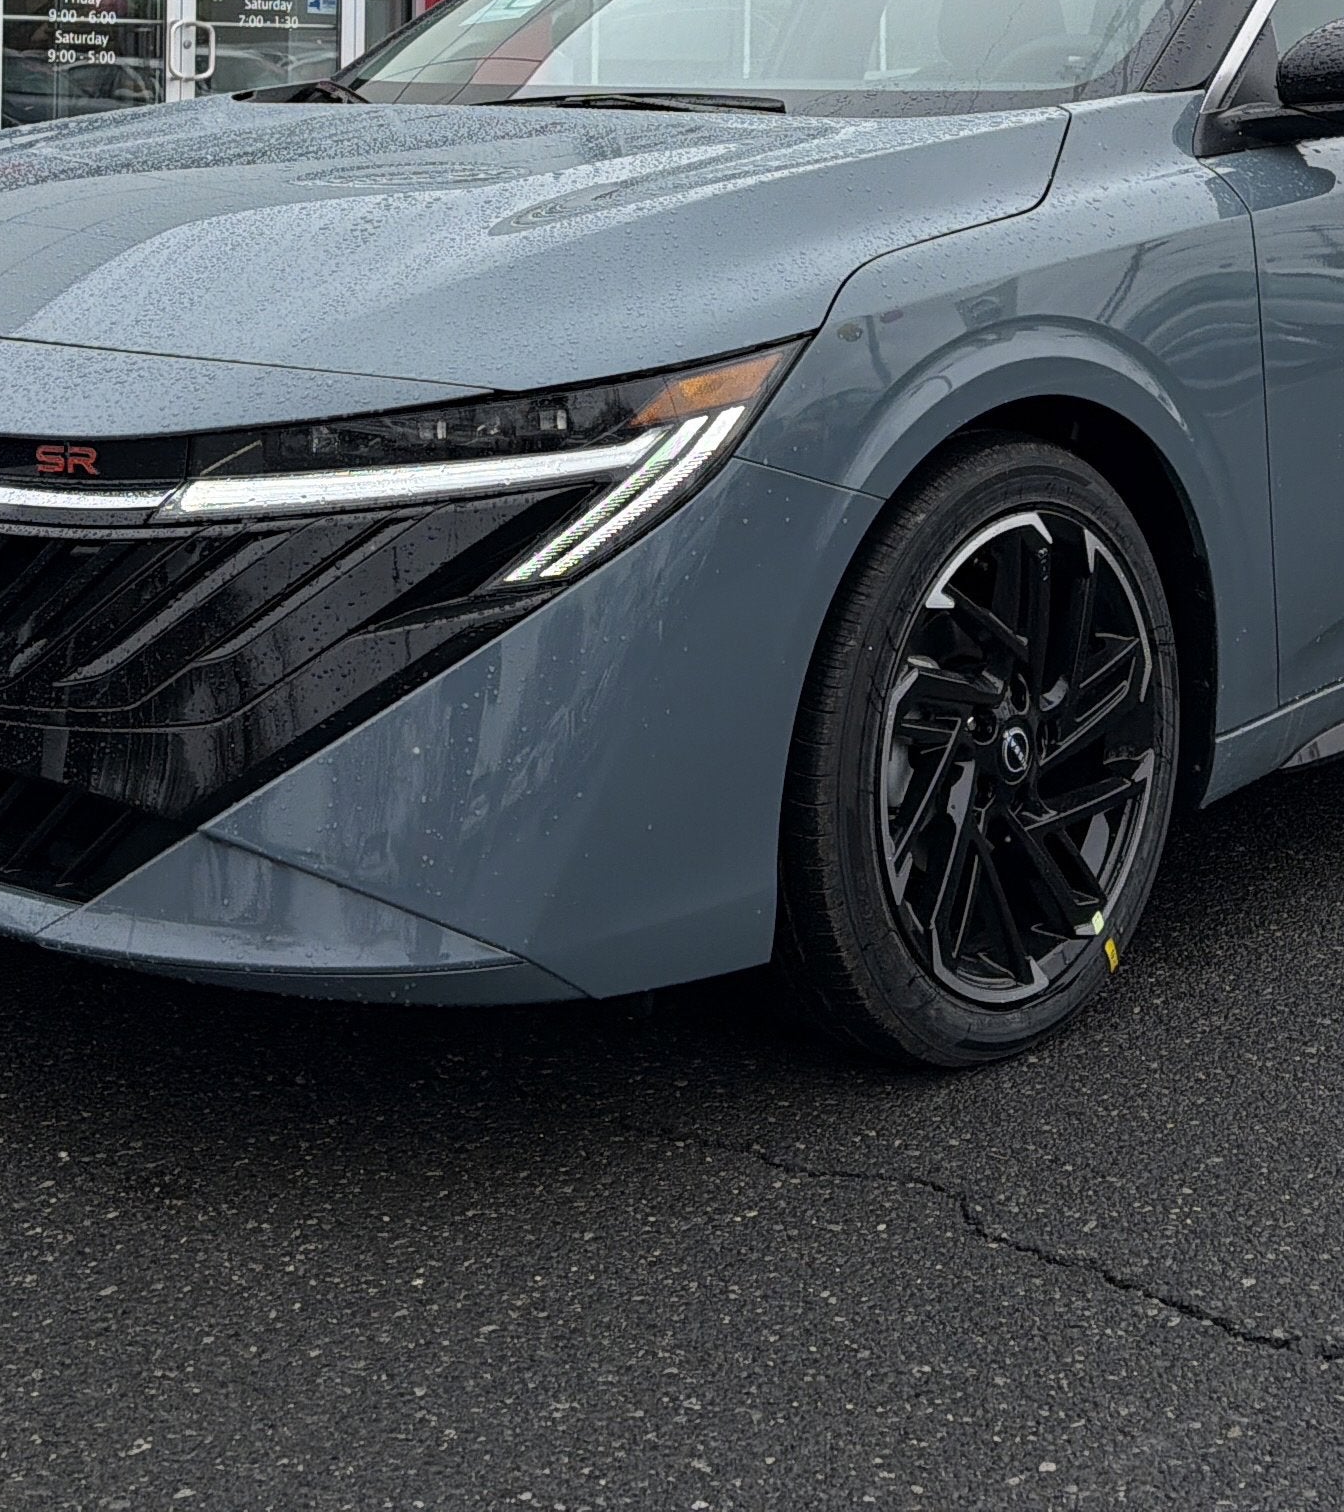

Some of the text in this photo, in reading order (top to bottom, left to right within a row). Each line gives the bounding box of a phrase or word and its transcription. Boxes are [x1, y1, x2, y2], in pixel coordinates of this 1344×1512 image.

[48, 9, 77, 22] 9:00
[88, 11, 117, 25] 6:00
[238, 15, 264, 28] 7:00
[275, 16, 299, 29] 1:30
[55, 30, 109, 47] Saturday
[47, 49, 76, 63] 9:00
[87, 50, 116, 64] 5:00
[36, 445, 100, 475] SR
